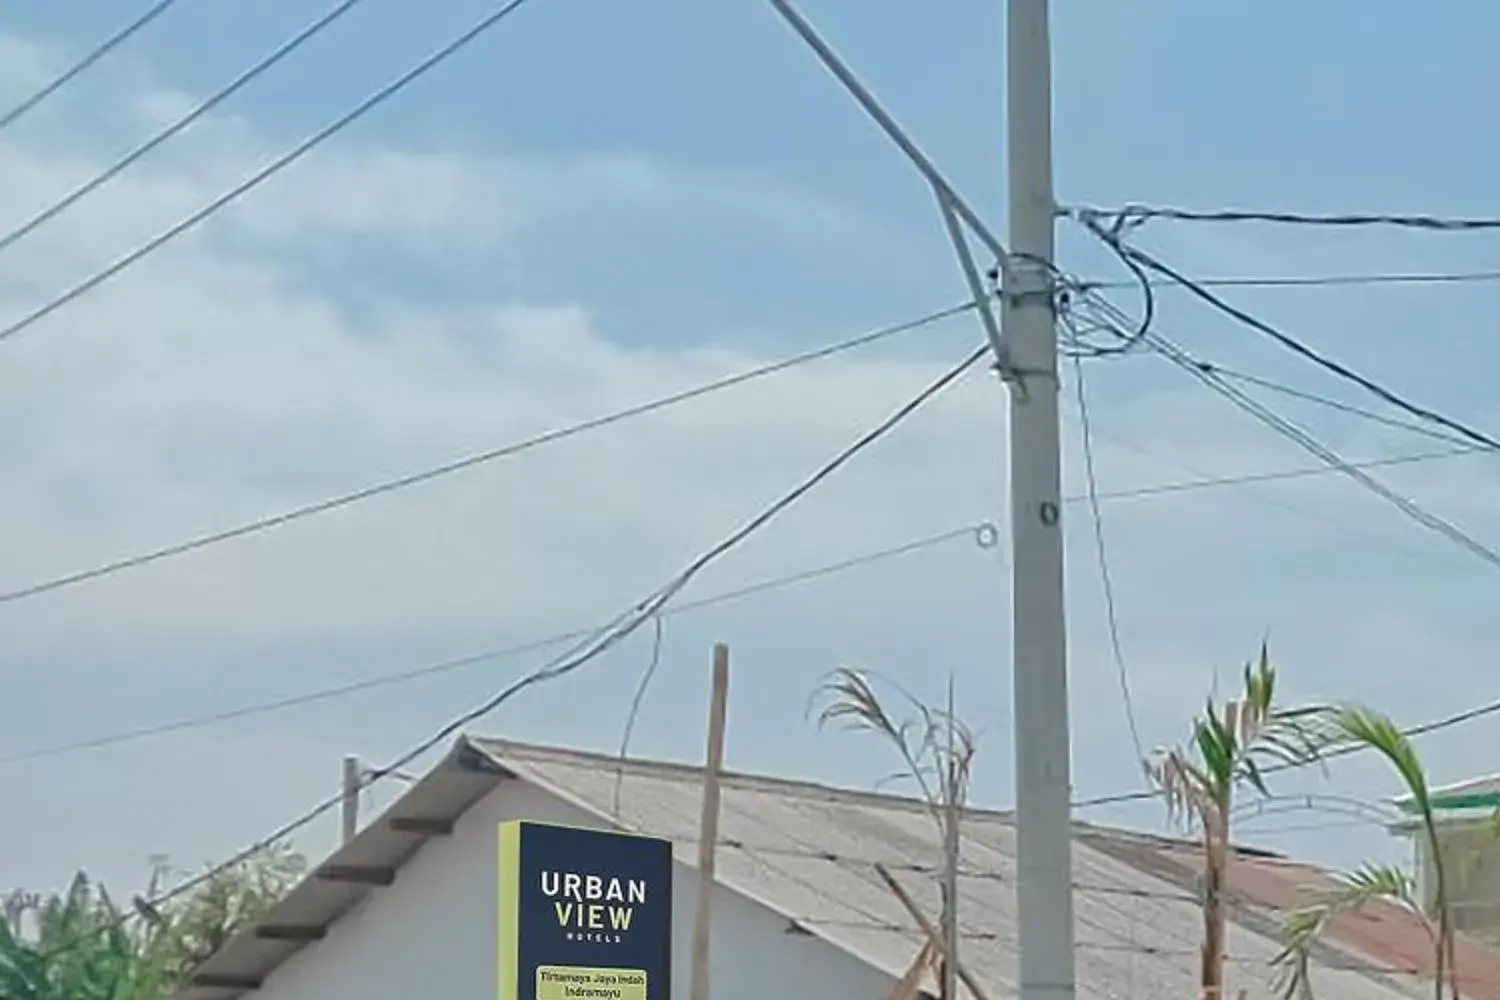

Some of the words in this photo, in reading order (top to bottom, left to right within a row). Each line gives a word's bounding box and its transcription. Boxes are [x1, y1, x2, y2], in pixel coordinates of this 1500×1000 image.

[541, 871, 645, 903] URBAN
[555, 901, 632, 930] VIEW
[566, 932, 621, 943] HOTELS
[593, 973, 616, 985] Jaya
[565, 986, 621, 1000] Indramayu
